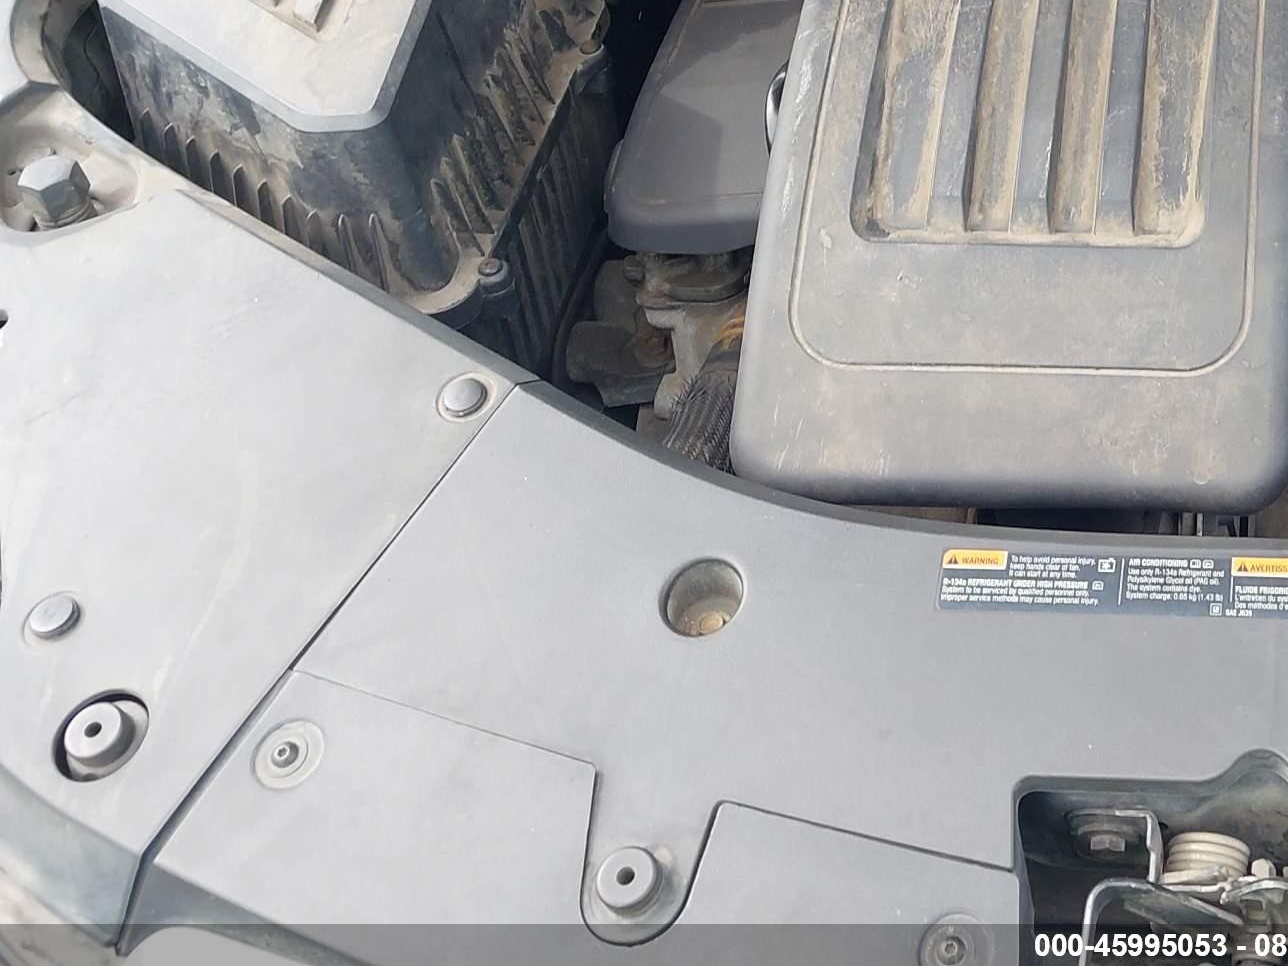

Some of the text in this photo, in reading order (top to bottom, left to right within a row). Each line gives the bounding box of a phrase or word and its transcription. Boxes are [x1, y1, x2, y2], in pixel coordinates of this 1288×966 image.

[962, 557, 999, 565] WARNING
[1020, 555, 1032, 564] help
[1050, 556, 1076, 564] personal
[1129, 558, 1188, 567] AIR CONDITIONING
[1026, 570, 1040, 578] start
[1140, 568, 1153, 576] only
[943, 578, 1088, 589] R-134a REFRIGERANT UNDER HIGH PRESSURE
[1140, 584, 1161, 592] system
[942, 586, 964, 594] System
[1018, 588, 1044, 596] qualified
[1235, 585, 1258, 594] FLUIDE
[941, 594, 968, 602] Improper
[1020, 596, 1033, 604] may
[1053, 597, 1079, 605] personal
[1126, 591, 1148, 600] System
[1189, 594, 1197, 602] kg
